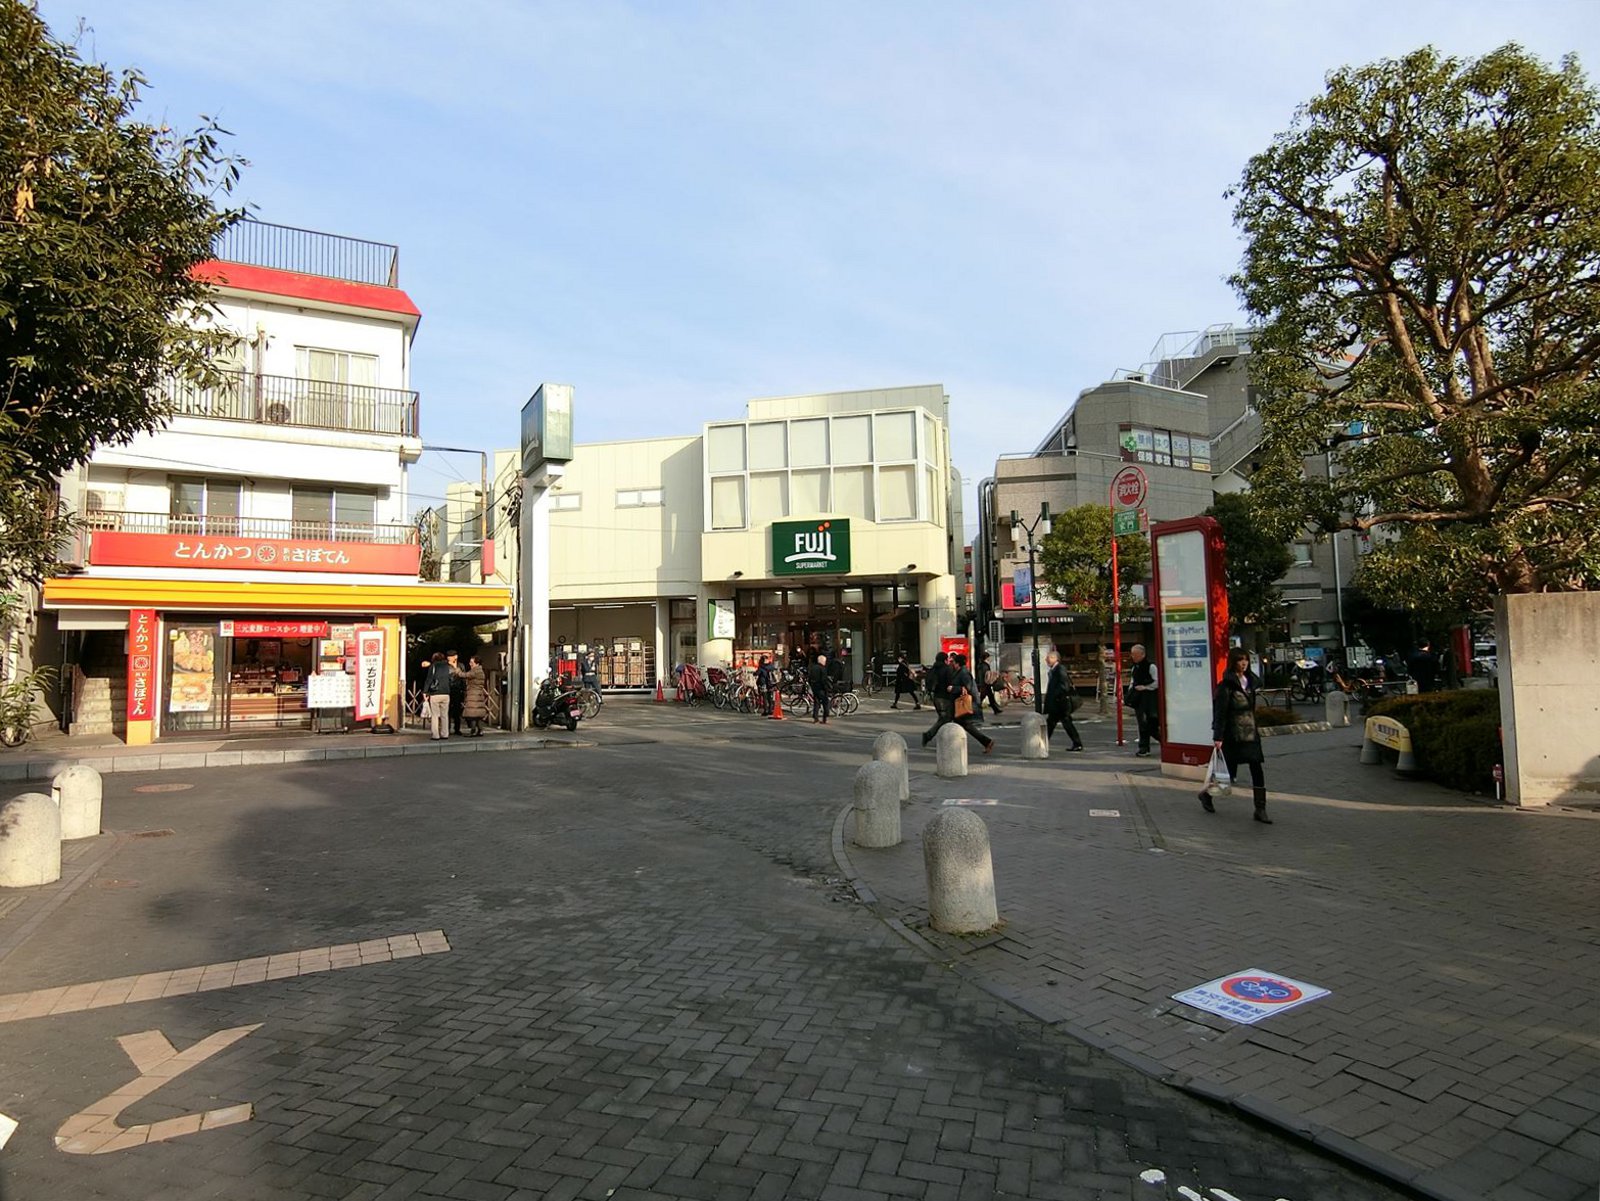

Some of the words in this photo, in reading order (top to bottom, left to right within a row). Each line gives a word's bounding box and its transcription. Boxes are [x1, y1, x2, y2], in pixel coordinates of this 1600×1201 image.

[1137, 450, 1154, 464] 保険
[1155, 453, 1172, 467] 事故
[1118, 481, 1139, 497] 消火栓
[795, 521, 832, 556] FUJI
[175, 542, 252, 560] とんかつ
[292, 547, 350, 564] さぼてん
[795, 561, 828, 569] SUPERMARKET
[136, 613, 149, 652] とんかつ
[1167, 626, 1206, 636] FamilyMart
[132, 677, 147, 715] さぼてん
